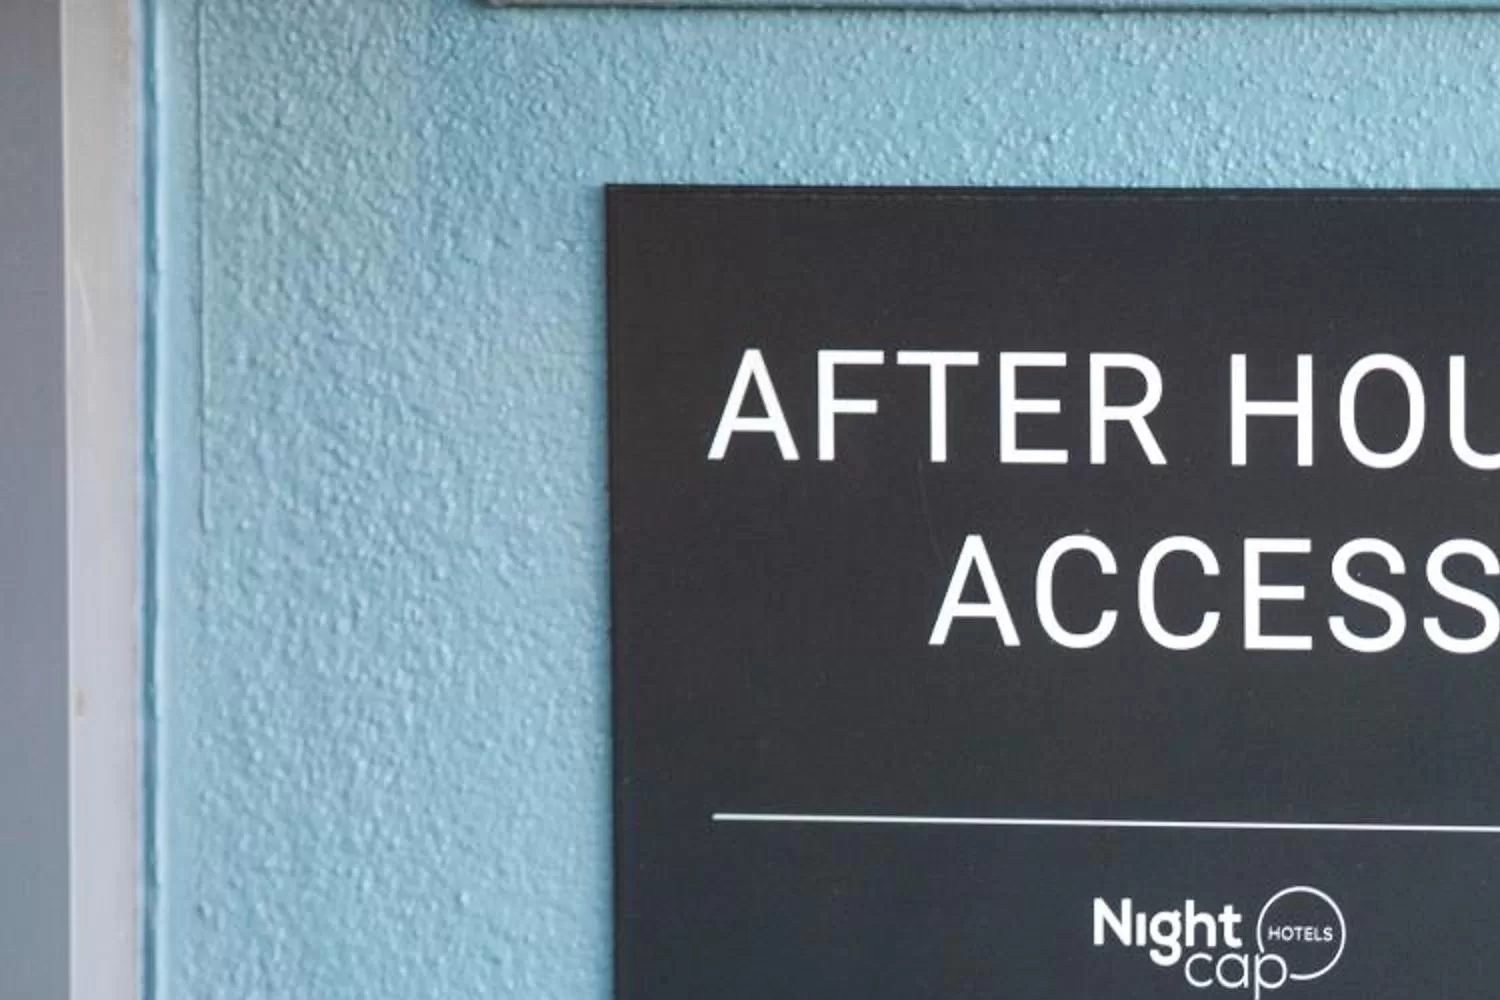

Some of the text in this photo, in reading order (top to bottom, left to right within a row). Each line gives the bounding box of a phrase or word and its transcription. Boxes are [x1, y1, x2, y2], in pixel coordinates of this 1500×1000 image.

[707, 348, 1168, 466] AFTER
[1093, 896, 1243, 967] Night
[1267, 925, 1334, 943] HOTELS
